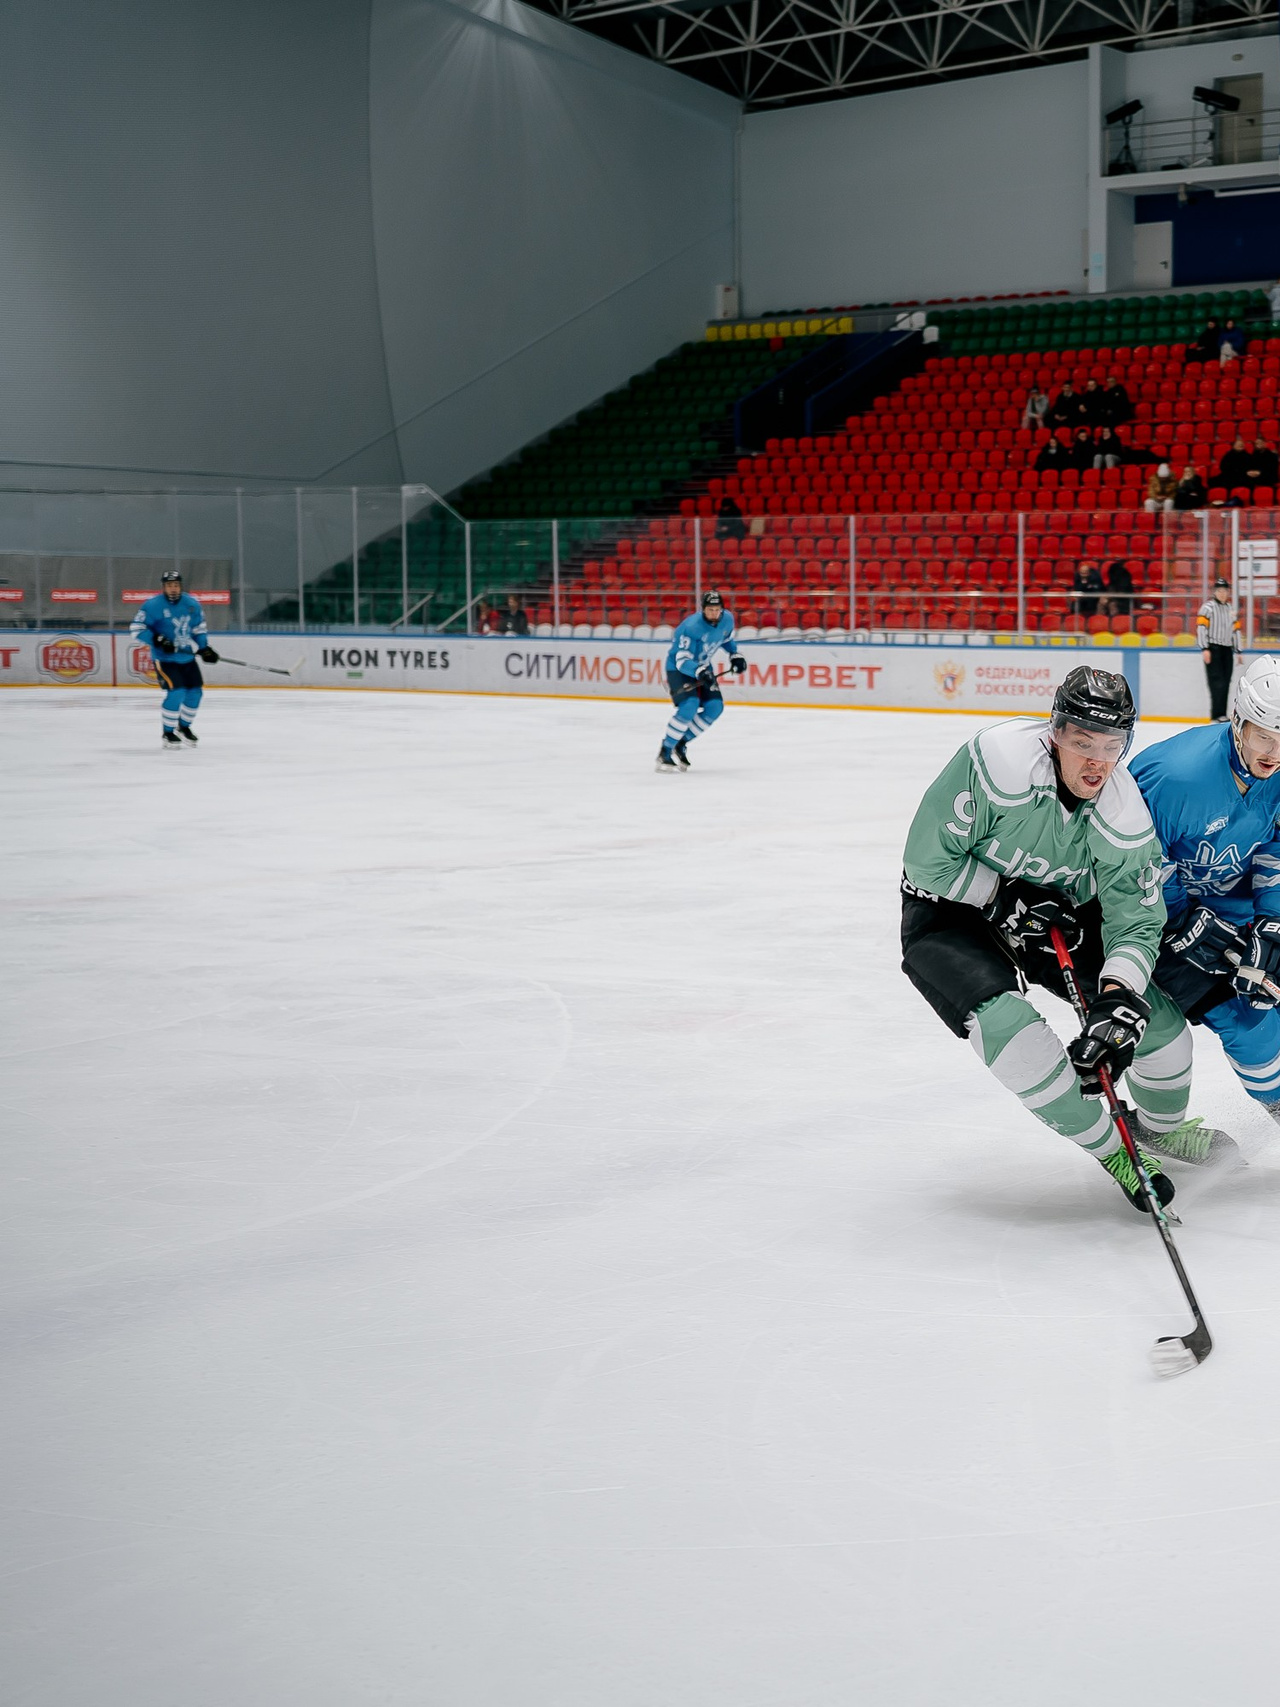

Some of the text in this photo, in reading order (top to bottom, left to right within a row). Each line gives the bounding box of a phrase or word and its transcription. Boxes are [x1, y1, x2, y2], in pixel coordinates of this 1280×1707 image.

[48, 647, 89, 657] PIZZA
[322, 648, 450, 670] IKON TYRES
[505, 652, 667, 686] СИТИМОБИ
[717, 662, 882, 690] LIMPBET
[974, 666, 1051, 680] ФЕДЕРАЦИЯ
[975, 683, 1058, 698] ХОККЕЯ РОС
[1089, 709, 1119, 722] CCM
[902, 878, 940, 903] CM
[1063, 969, 1082, 1009] CCM
